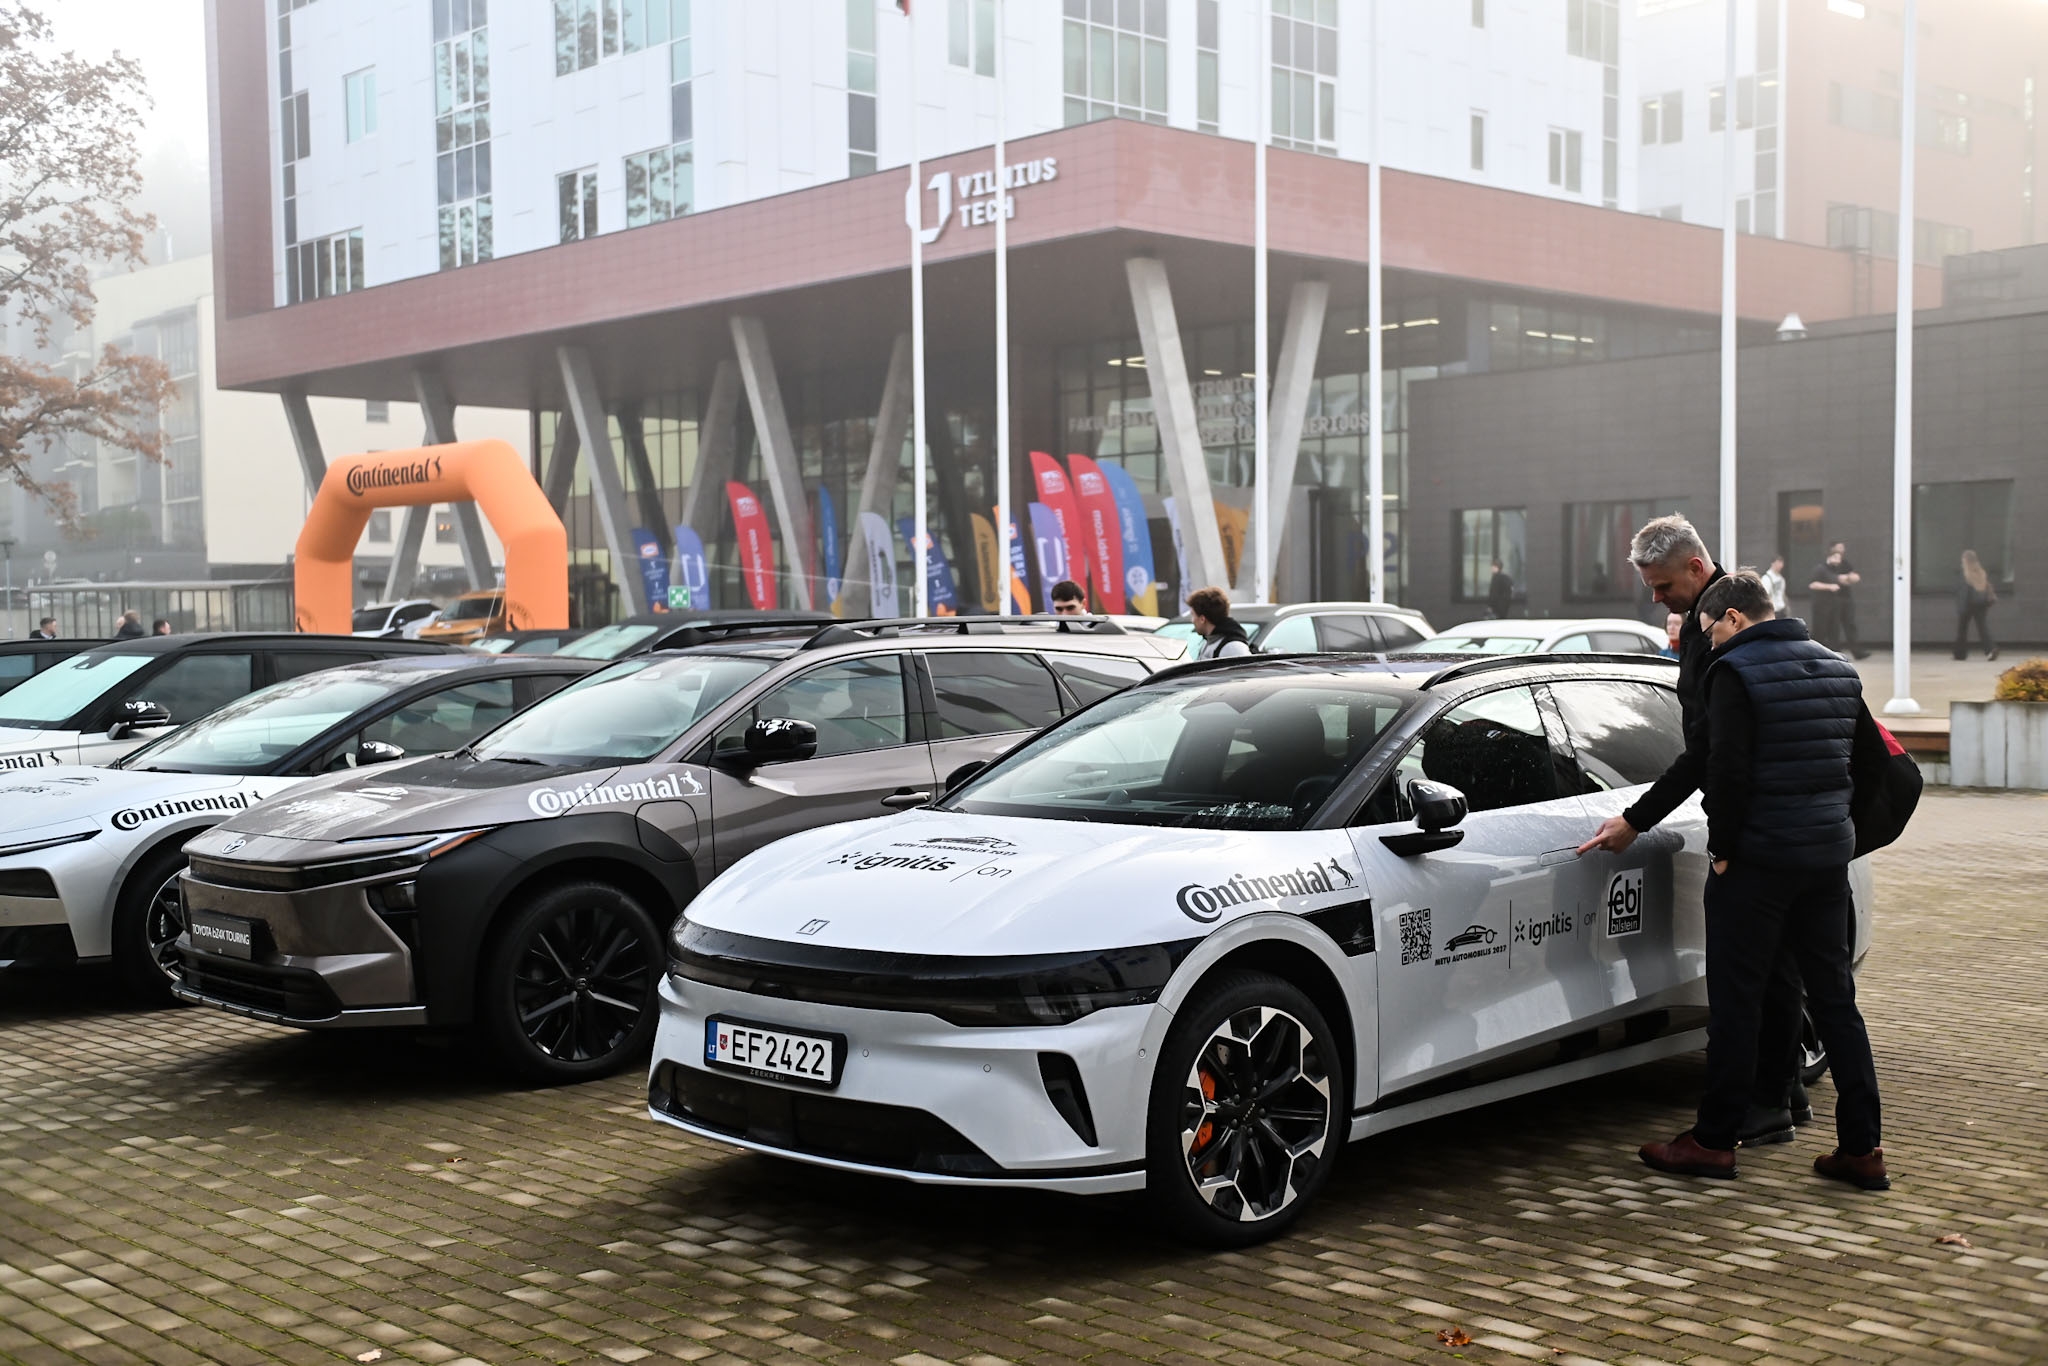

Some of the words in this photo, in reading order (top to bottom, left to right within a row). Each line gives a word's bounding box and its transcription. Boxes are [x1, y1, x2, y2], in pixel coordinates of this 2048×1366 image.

[957, 156, 1058, 199] VILNIUS
[958, 195, 1015, 228] TECH
[346, 458, 431, 497] Continental
[755, 719, 794, 736] tv3.lt
[111, 791, 249, 831] Continental
[528, 773, 683, 818] Continental
[853, 851, 957, 872] ignitis
[977, 865, 1013, 879] on
[1175, 862, 1336, 924] Continental
[1607, 874, 1642, 917] febi
[192, 923, 212, 937] TOYOTA
[226, 930, 250, 945] TOURING
[1528, 911, 1573, 946] ignitis
[1610, 917, 1638, 934] bilstein
[1452, 947, 1492, 963] AUTOMOBILIS
[708, 1044, 716, 1054] LT
[732, 1029, 825, 1076] EF2422
